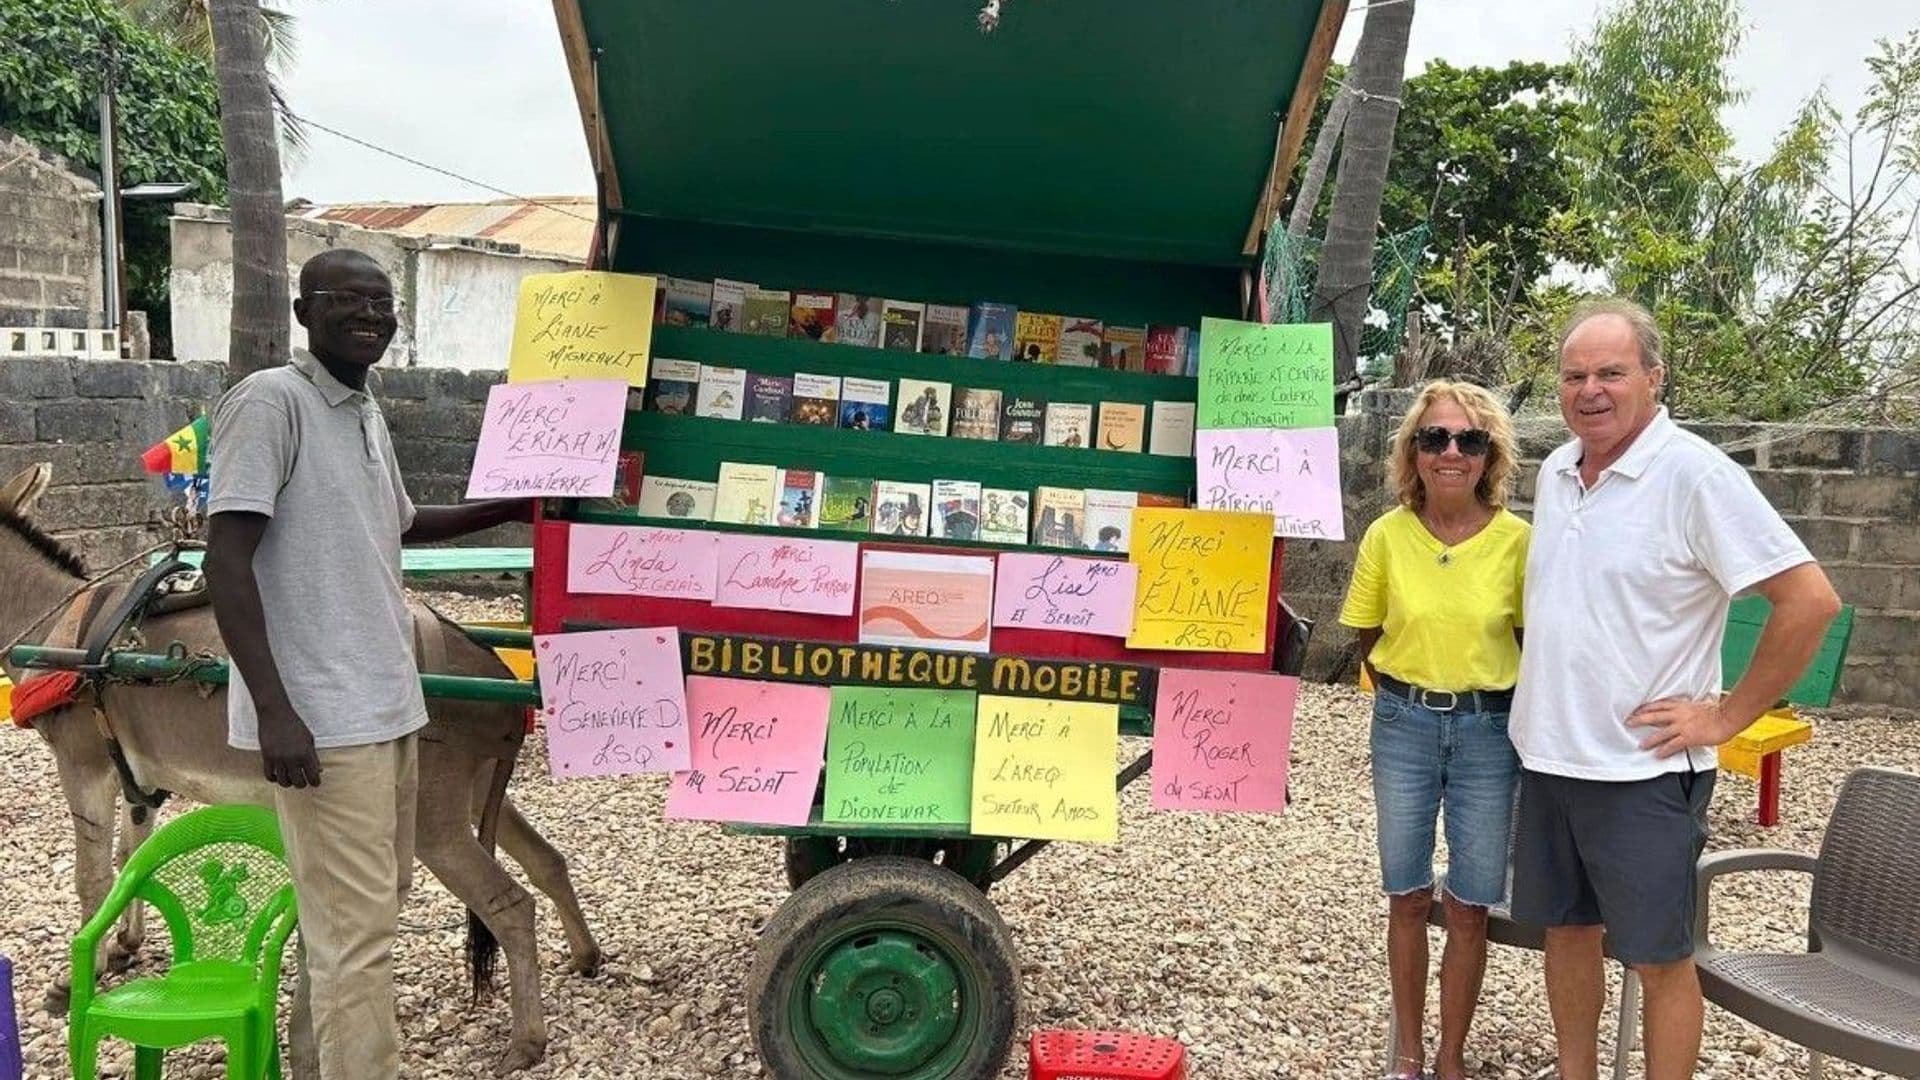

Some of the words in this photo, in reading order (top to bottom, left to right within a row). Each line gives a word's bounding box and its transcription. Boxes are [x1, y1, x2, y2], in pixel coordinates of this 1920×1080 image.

[532, 313, 608, 342] LIANE
[586, 531, 679, 583] Linda
[1025, 555, 1098, 608] Lise
[690, 636, 977, 687] BIBLIOTHÈQUE
[993, 656, 1139, 700] MOBILE
